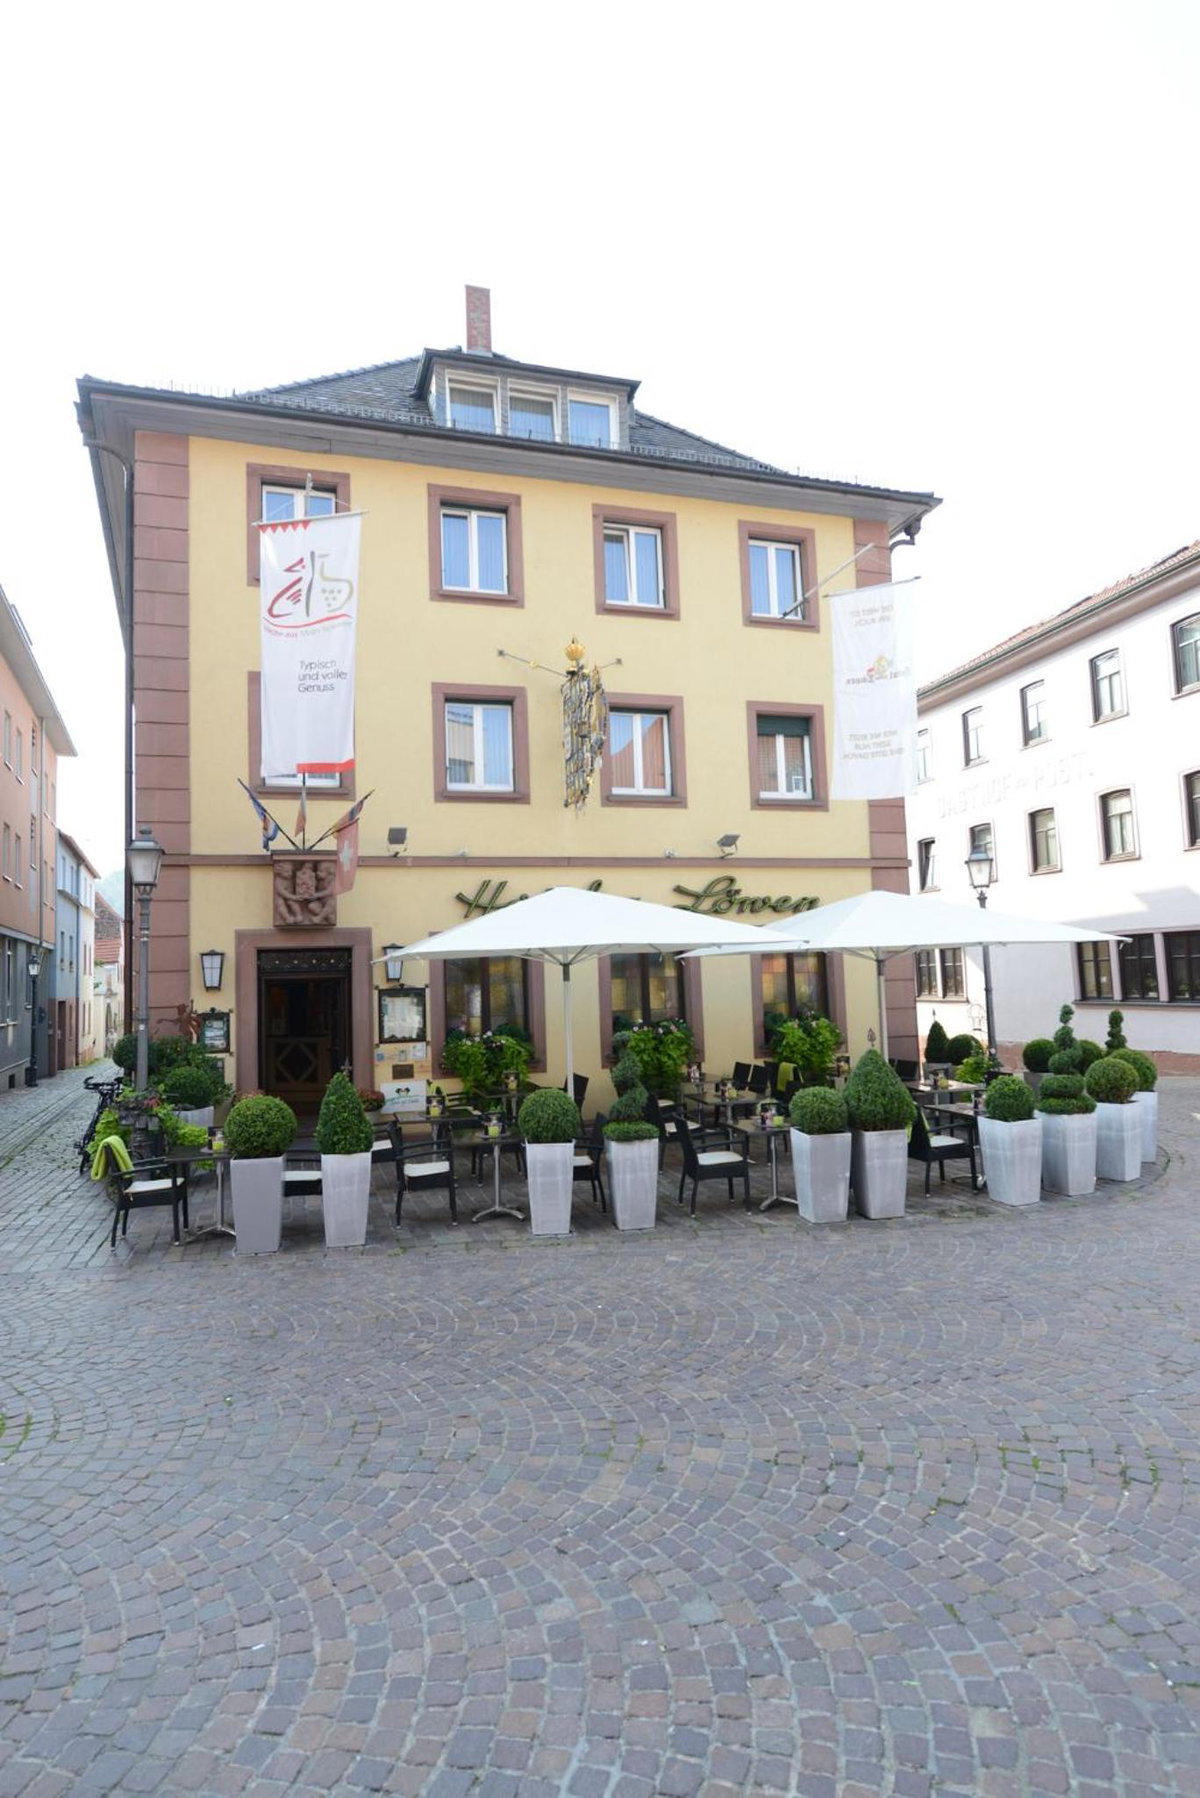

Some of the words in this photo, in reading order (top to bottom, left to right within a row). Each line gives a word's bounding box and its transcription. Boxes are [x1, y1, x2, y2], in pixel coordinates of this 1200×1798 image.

[299, 659, 337, 672] Typisch
[298, 671, 319, 681] und
[297, 683, 336, 693] Genuss
[672, 875, 820, 915] Löwen
